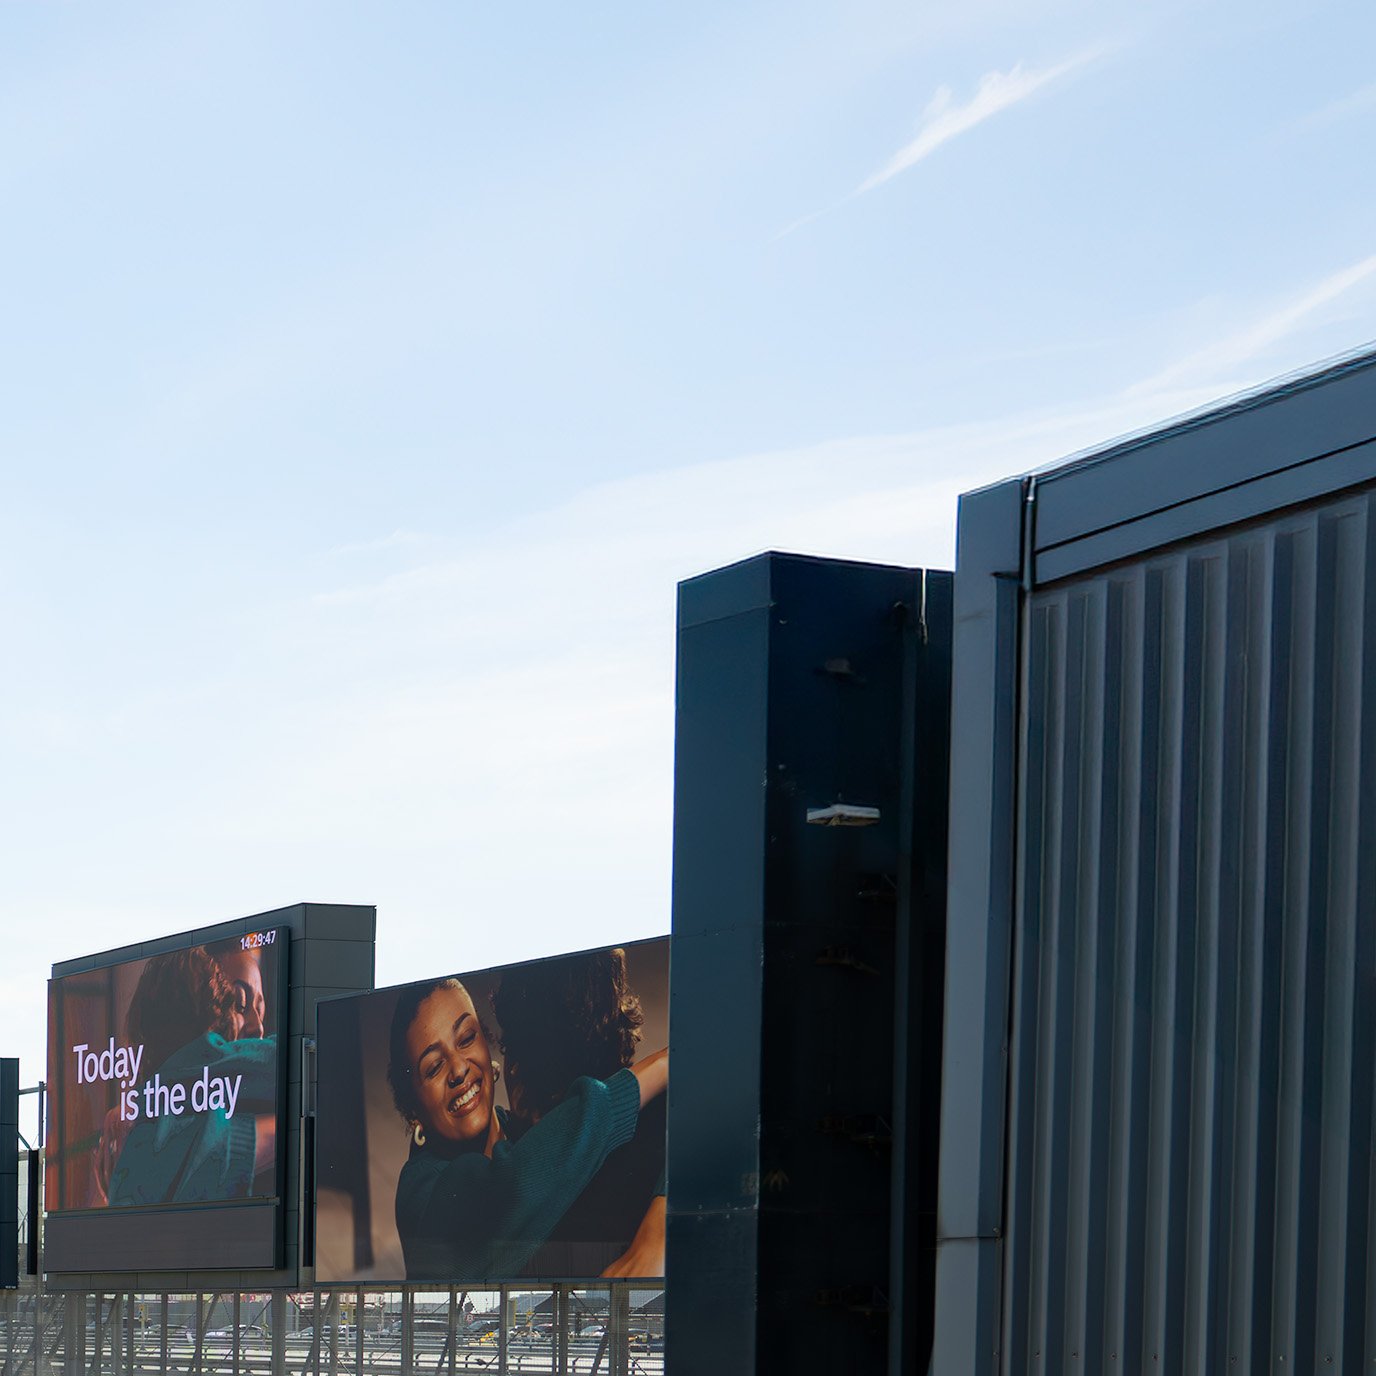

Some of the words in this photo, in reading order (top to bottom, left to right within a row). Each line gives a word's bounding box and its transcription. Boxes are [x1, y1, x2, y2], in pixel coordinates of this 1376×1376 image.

[240, 930, 276, 950] 14:29:47
[73, 1037, 144, 1087] Today
[120, 1080, 139, 1121] is
[143, 1073, 186, 1118] the
[191, 1066, 242, 1119] day
